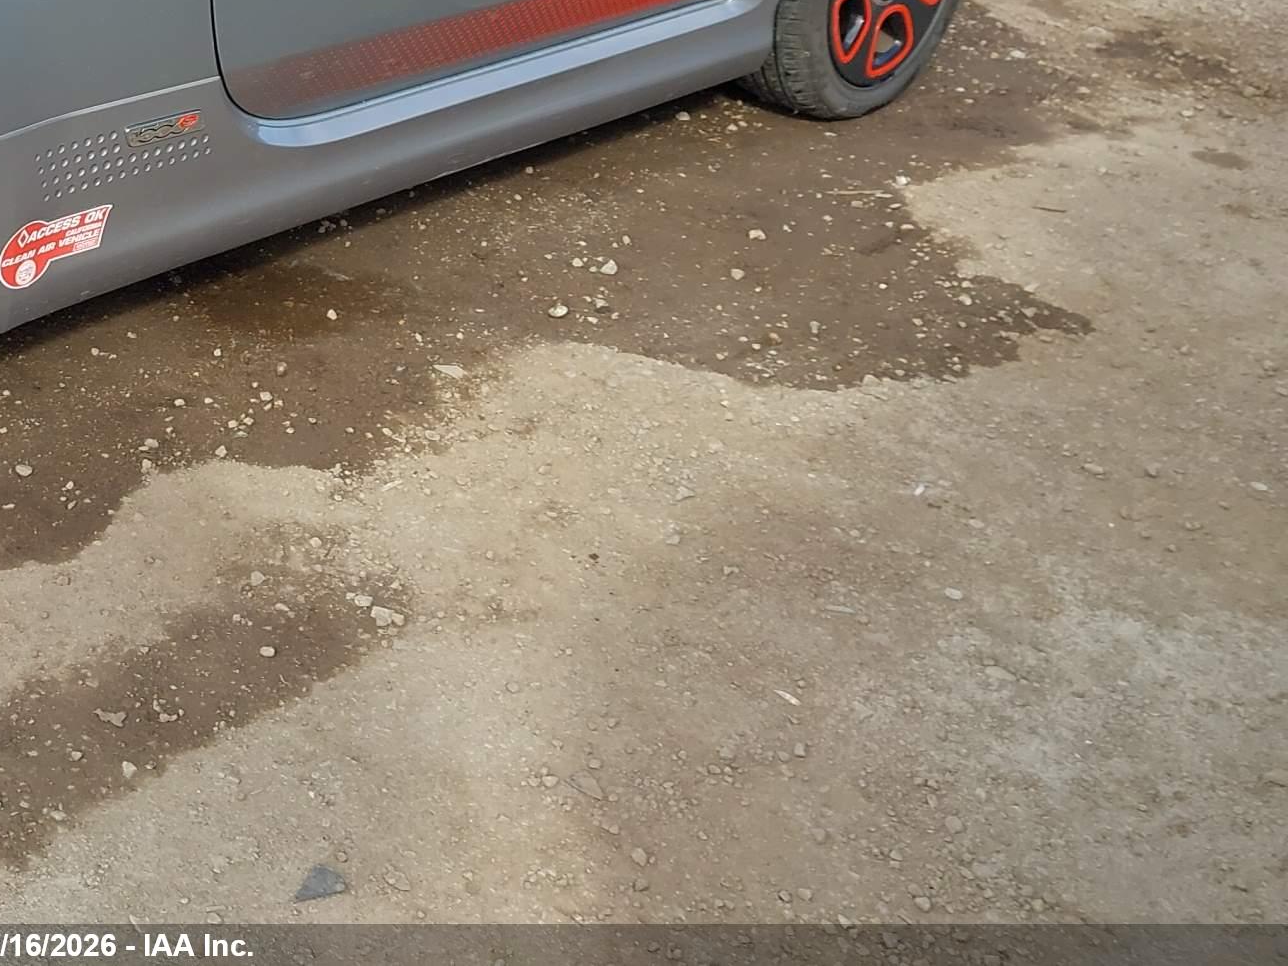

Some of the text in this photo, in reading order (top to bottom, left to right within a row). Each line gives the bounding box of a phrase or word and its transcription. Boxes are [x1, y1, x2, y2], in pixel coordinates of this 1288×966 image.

[26, 215, 82, 244] ACCESS
[84, 208, 106, 225] OK
[2, 249, 36, 268] CLEAN
[37, 241, 57, 255] AIR
[58, 228, 100, 248] VEHICLE
